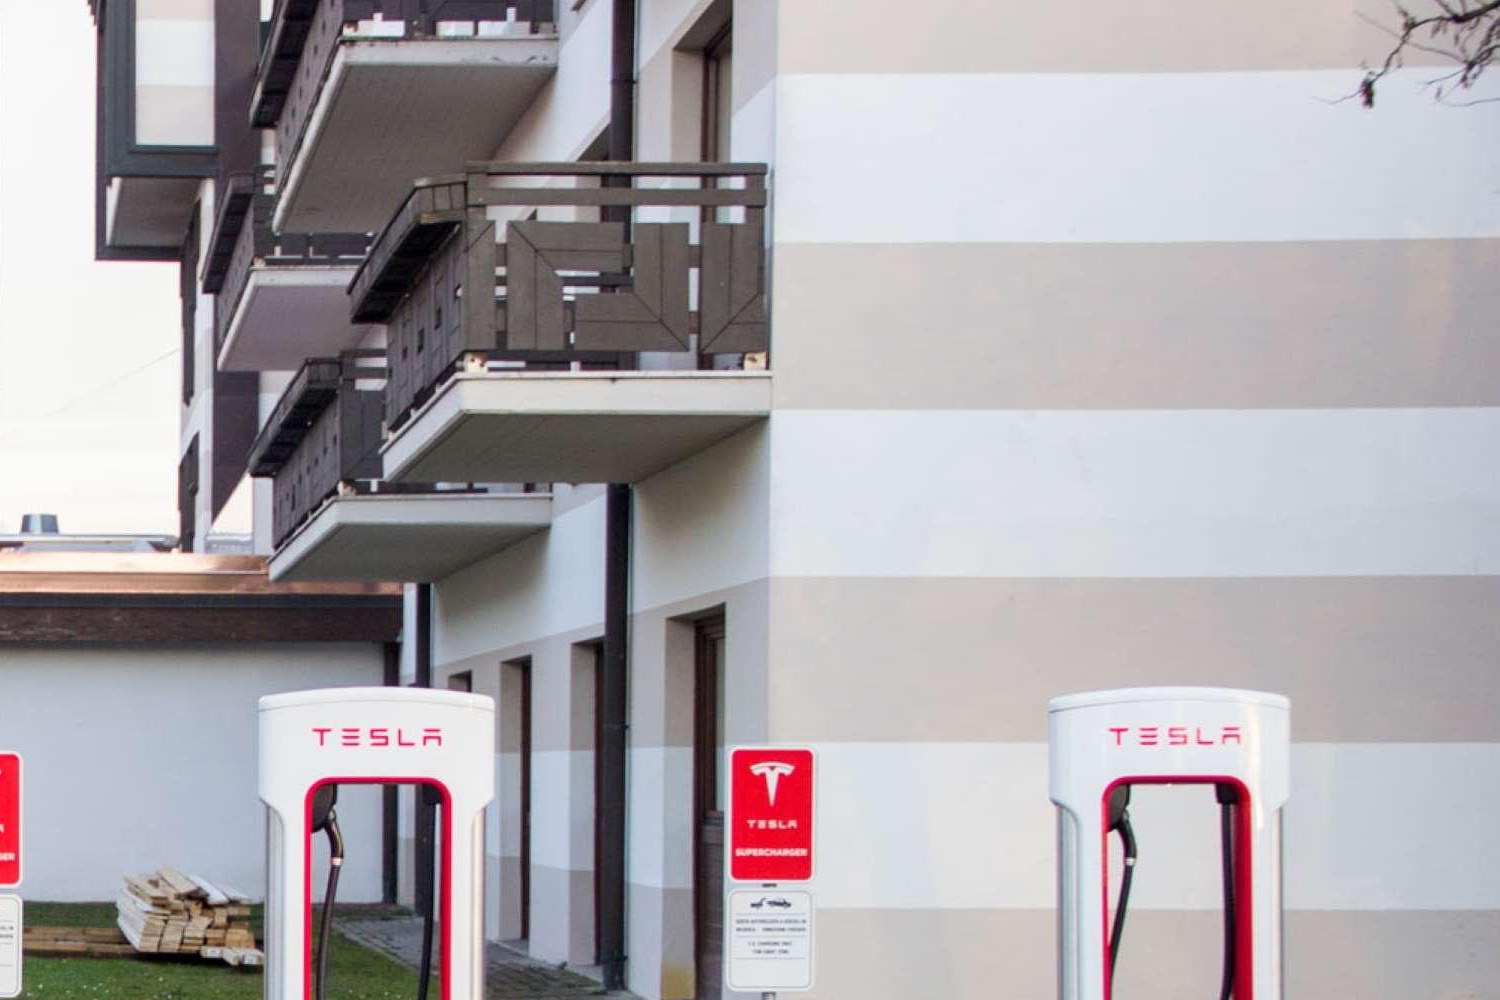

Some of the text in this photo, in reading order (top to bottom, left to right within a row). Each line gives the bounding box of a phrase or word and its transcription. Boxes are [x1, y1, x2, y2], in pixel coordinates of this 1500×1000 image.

[311, 727, 443, 747] TESLA
[1107, 726, 1241, 746] TESLA
[746, 819, 798, 829] TESLA
[735, 847, 808, 857] SUPERCHARGER
